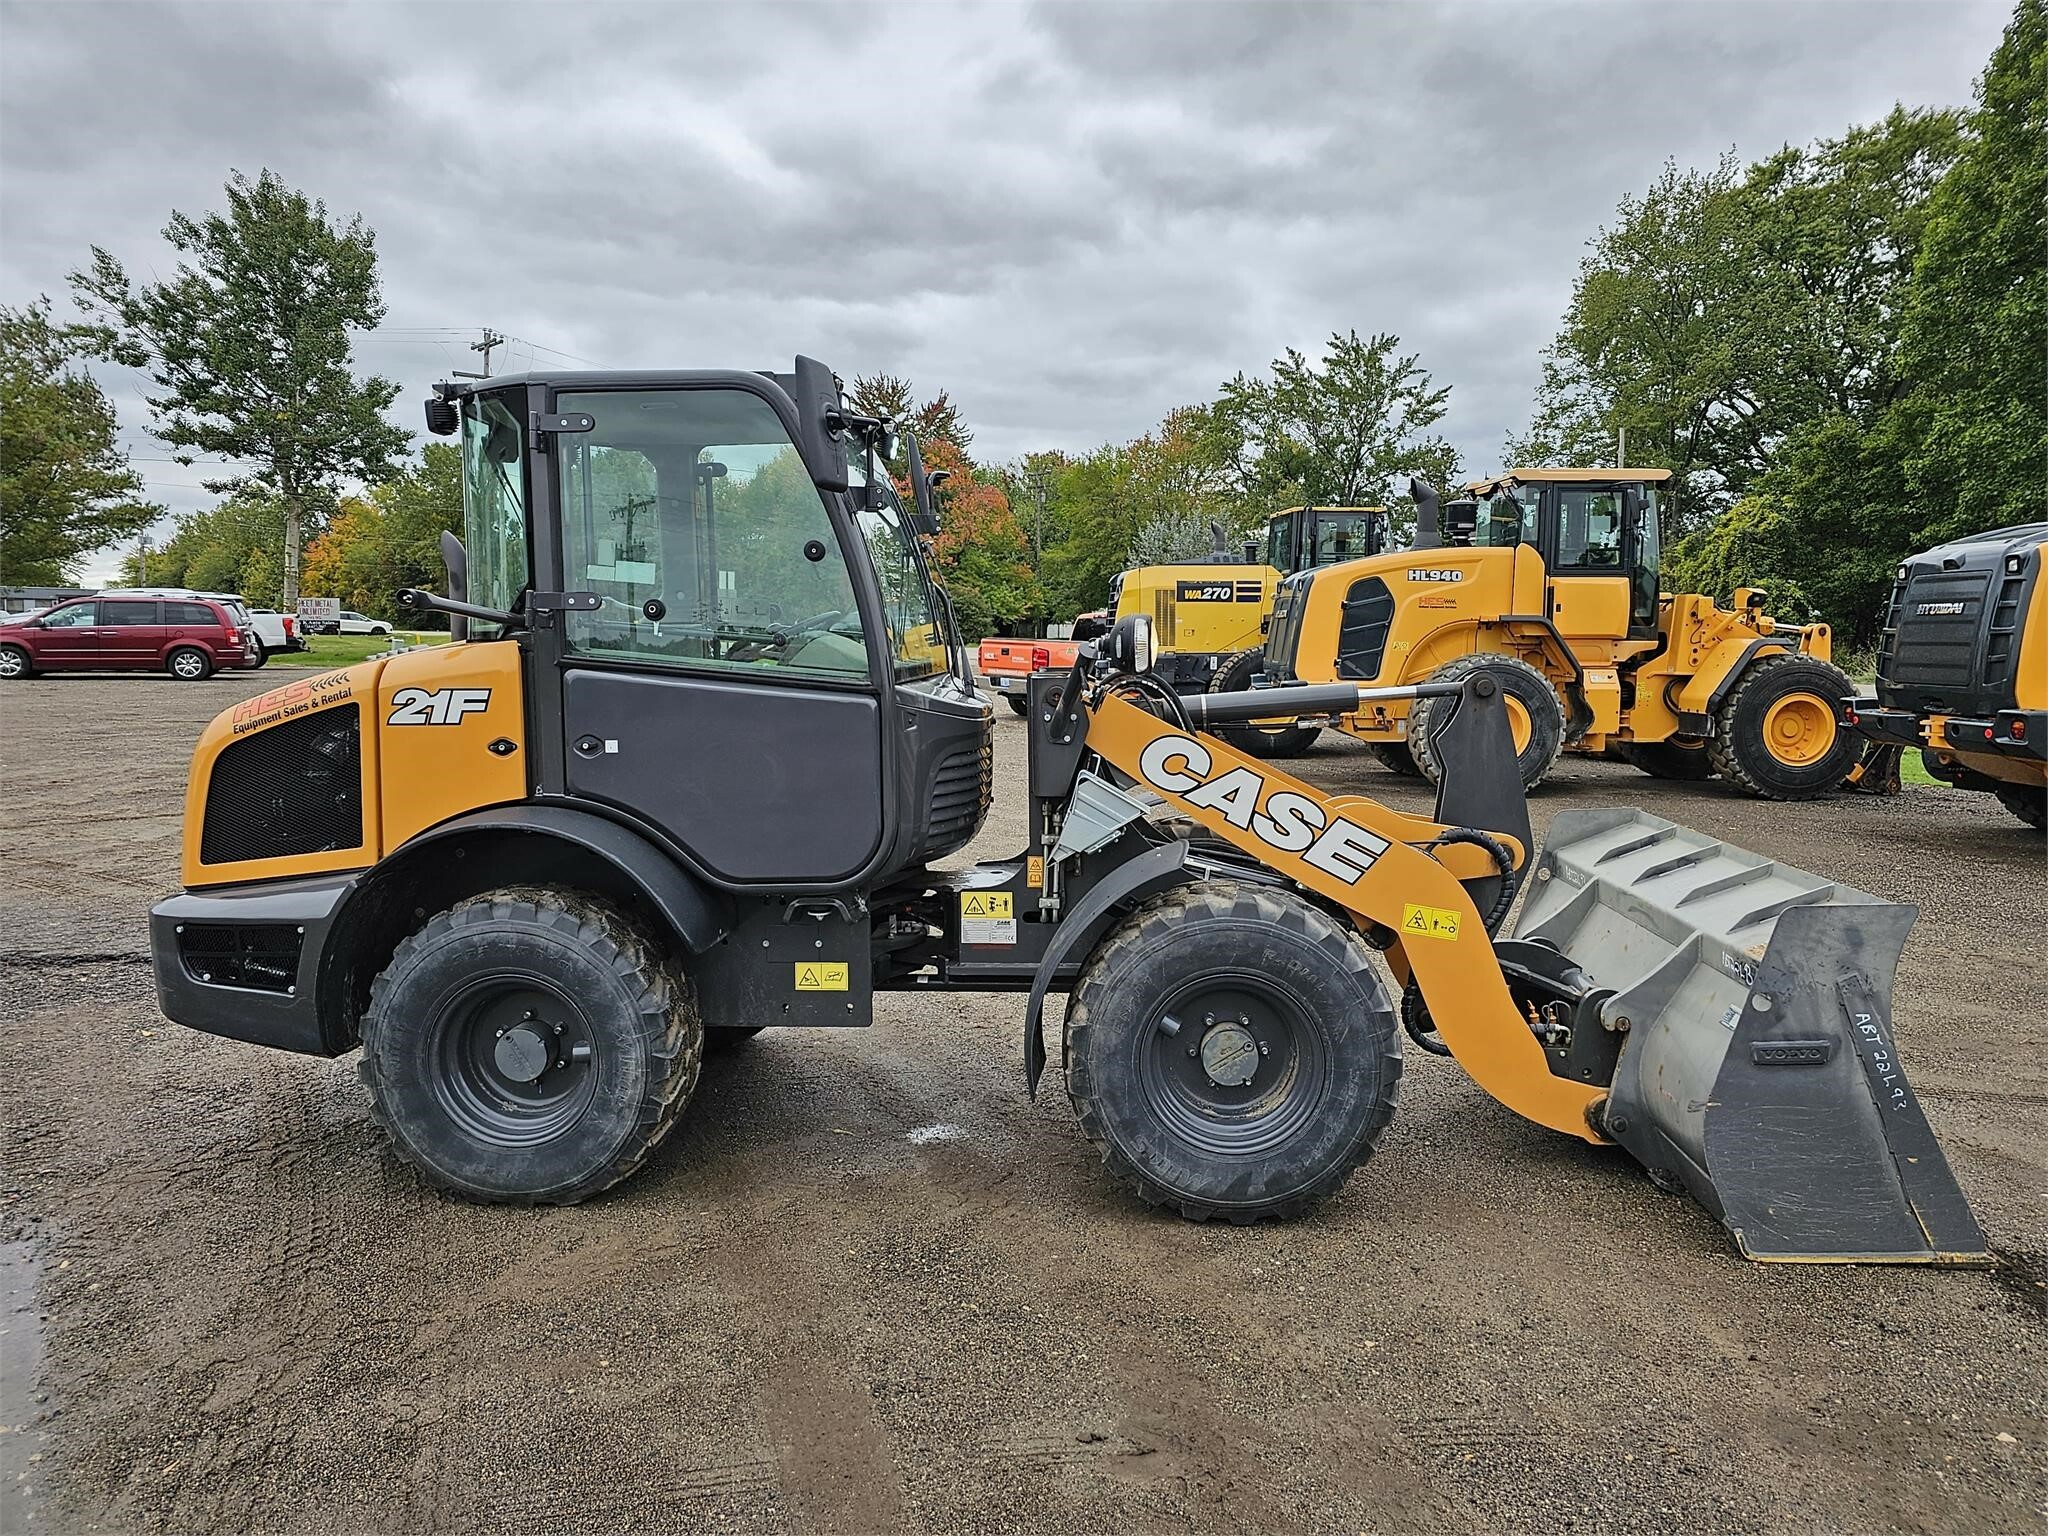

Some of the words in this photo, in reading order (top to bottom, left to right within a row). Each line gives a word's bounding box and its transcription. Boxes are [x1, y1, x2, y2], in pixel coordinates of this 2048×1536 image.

[1408, 569, 1463, 582] HL940
[1184, 587, 1231, 600] WA270
[1916, 602, 1964, 615] HYUNDAI
[233, 680, 312, 723] HES
[233, 711, 282, 735] Equipment
[283, 702, 309, 717] Sales
[311, 698, 319, 708] &
[321, 687, 352, 706] Rental
[386, 687, 492, 726] 21F
[1139, 734, 1393, 887] CASE
[1855, 1013, 1884, 1045] ABT
[1760, 1049, 1821, 1059] VOLVO
